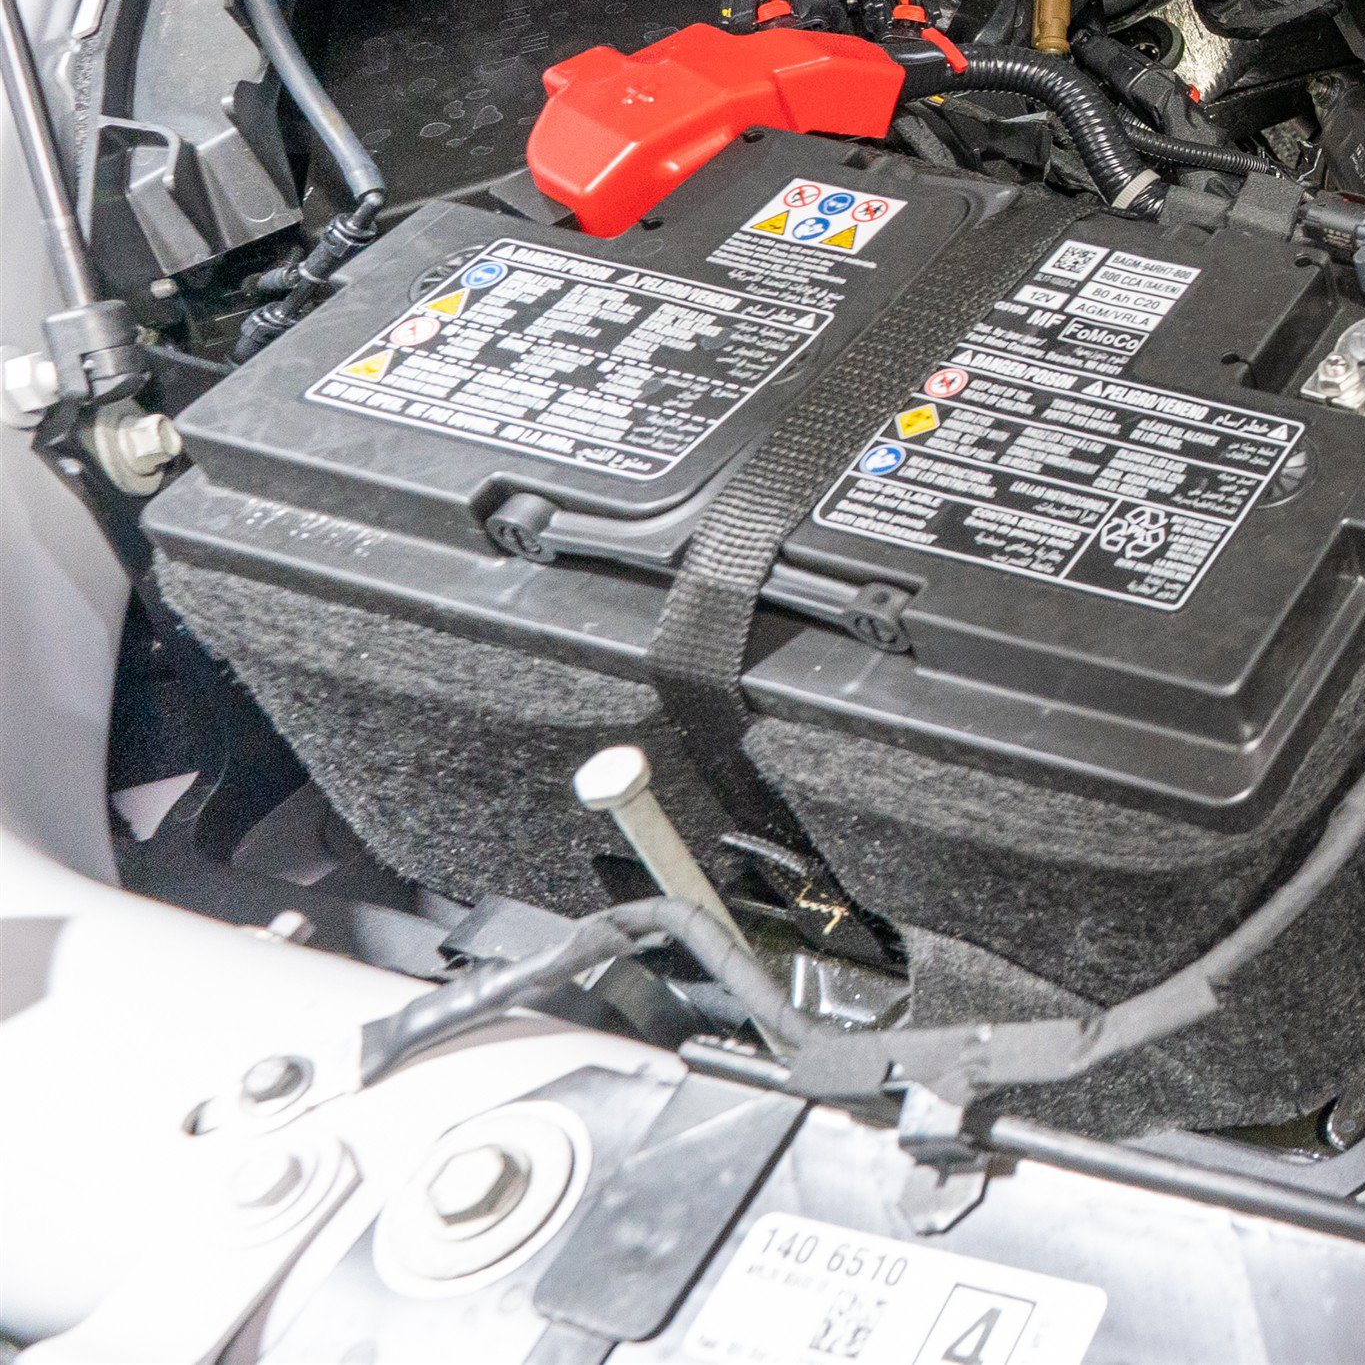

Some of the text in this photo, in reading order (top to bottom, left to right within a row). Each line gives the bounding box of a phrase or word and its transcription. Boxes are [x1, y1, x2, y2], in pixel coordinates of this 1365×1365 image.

[1100, 270, 1120, 284] 800
[1121, 274, 1142, 288] CCA
[1030, 291, 1057, 303] 12V
[1091, 287, 1161, 310] 80 Ah C20
[1026, 309, 1066, 328] MF
[1075, 302, 1150, 326] AGM/VRLA
[1065, 322, 1140, 351] FoMoCo
[970, 353, 1079, 390] DANGER/POISON
[1101, 384, 1210, 421] PELIGRO/VENENO
[762, 1226, 819, 1264] 140
[826, 1241, 909, 1287] 6510
[941, 1306, 1001, 1365] 4
